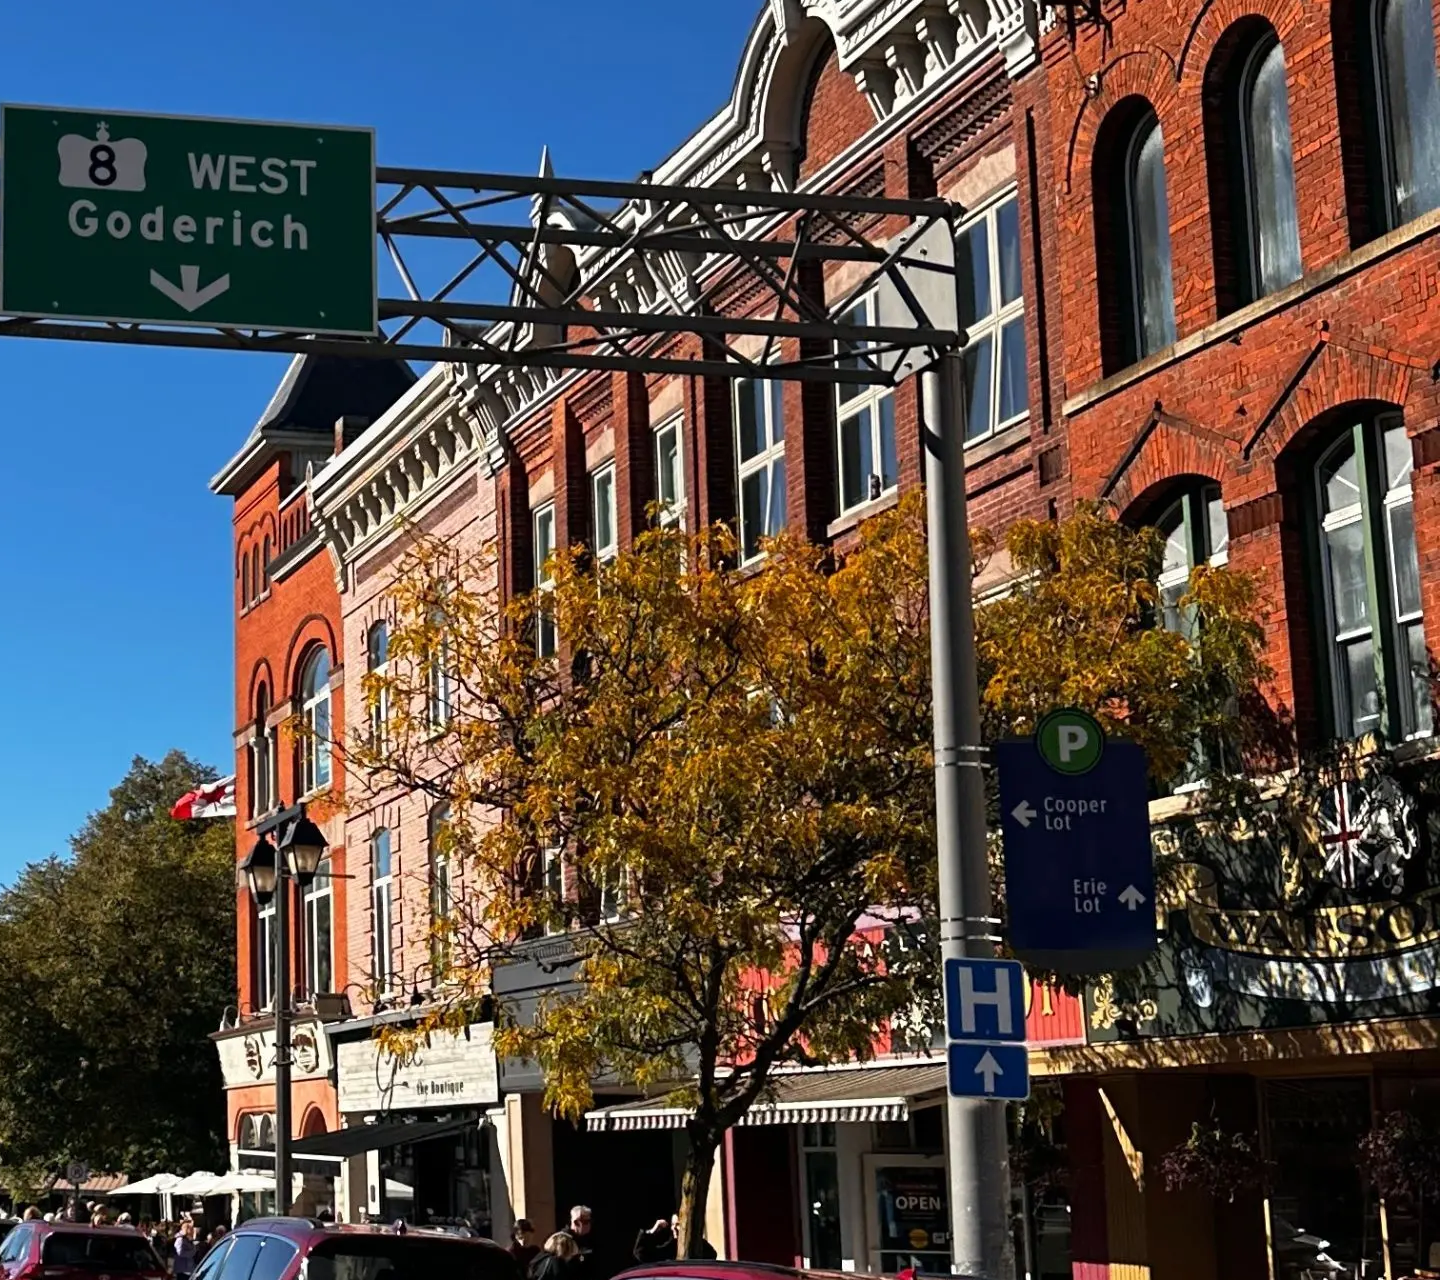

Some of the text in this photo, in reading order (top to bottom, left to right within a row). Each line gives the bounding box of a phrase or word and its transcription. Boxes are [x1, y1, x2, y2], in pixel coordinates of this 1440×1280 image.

[88, 143, 117, 186] 8
[187, 151, 317, 196] WEST
[68, 198, 308, 250] Goderich
[1057, 725, 1088, 762] P
[1043, 796, 1107, 816] Cooper
[1044, 816, 1072, 831] Lot
[1073, 878, 1108, 895] Erie
[1074, 896, 1101, 913] Lot
[1205, 902, 1439, 951] WATSO
[958, 966, 1013, 1034] H
[431, 1080, 464, 1097] Boutique
[895, 1196, 941, 1210] OPEN
